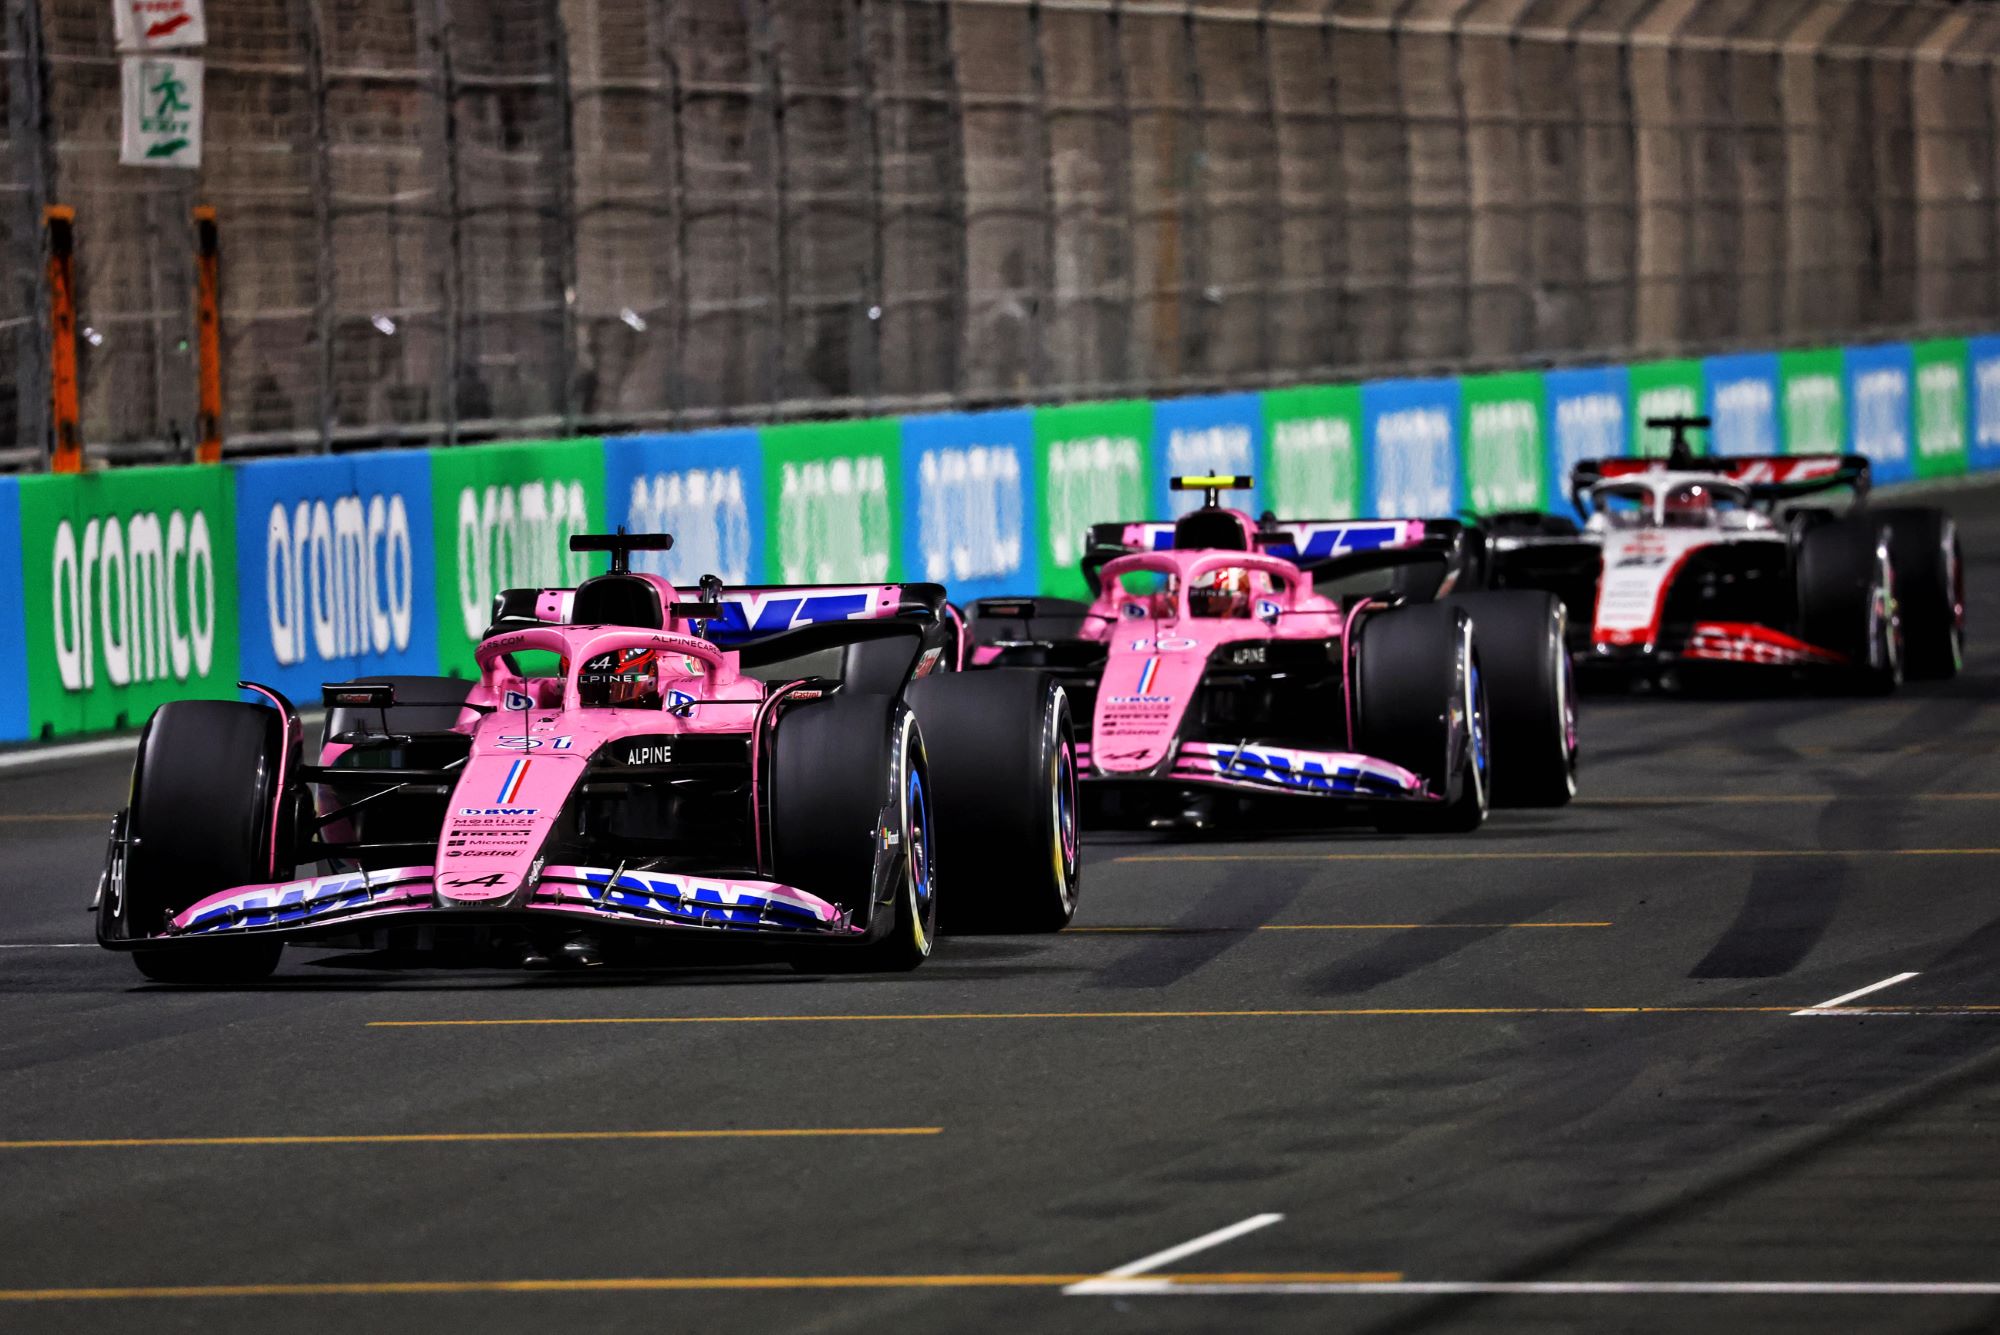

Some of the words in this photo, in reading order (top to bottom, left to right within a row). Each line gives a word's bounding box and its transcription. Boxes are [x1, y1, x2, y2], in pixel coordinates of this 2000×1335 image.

[267, 494, 412, 665] aramco
[52, 509, 215, 692] aramco
[1233, 647, 1266, 664] ALPINE
[580, 674, 632, 683] LPINE
[494, 735, 573, 750] 31
[628, 746, 672, 765] ALPINE
[450, 829, 532, 837] PIRELLI
[463, 849, 518, 857] Castrol
